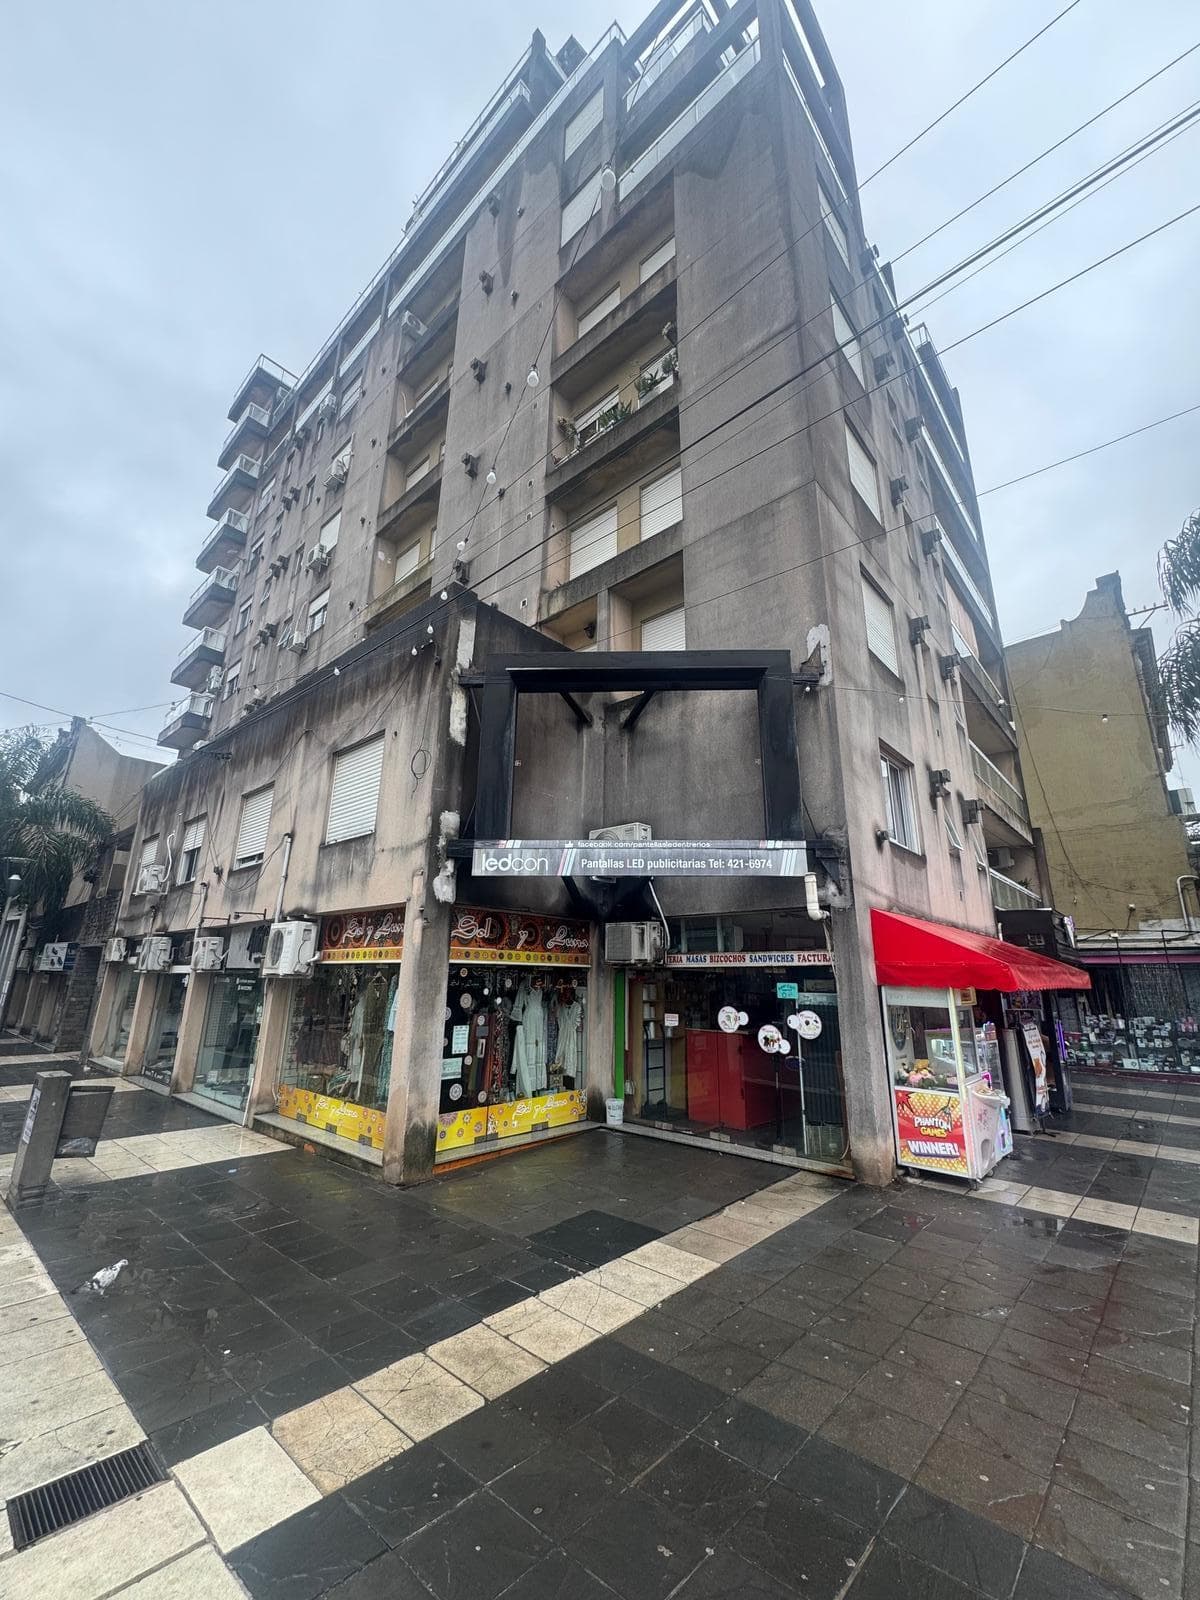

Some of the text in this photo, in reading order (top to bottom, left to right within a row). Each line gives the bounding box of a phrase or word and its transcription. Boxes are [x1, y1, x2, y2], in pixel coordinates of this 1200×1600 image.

[481, 853, 549, 872] ledcon
[581, 858, 773, 871] Pantallas LED publicitarias Tel: 421-6974
[374, 912, 405, 940] Lun
[451, 915, 589, 950] Sol y Luna
[686, 954, 707, 963] MASAS
[709, 954, 746, 964] BIZCOCHOS
[749, 954, 795, 963] SANDWICHES
[913, 1116, 952, 1133] PHANTOM
[919, 1126, 948, 1138] GAMES
[907, 1140, 961, 1157] WINNER!
